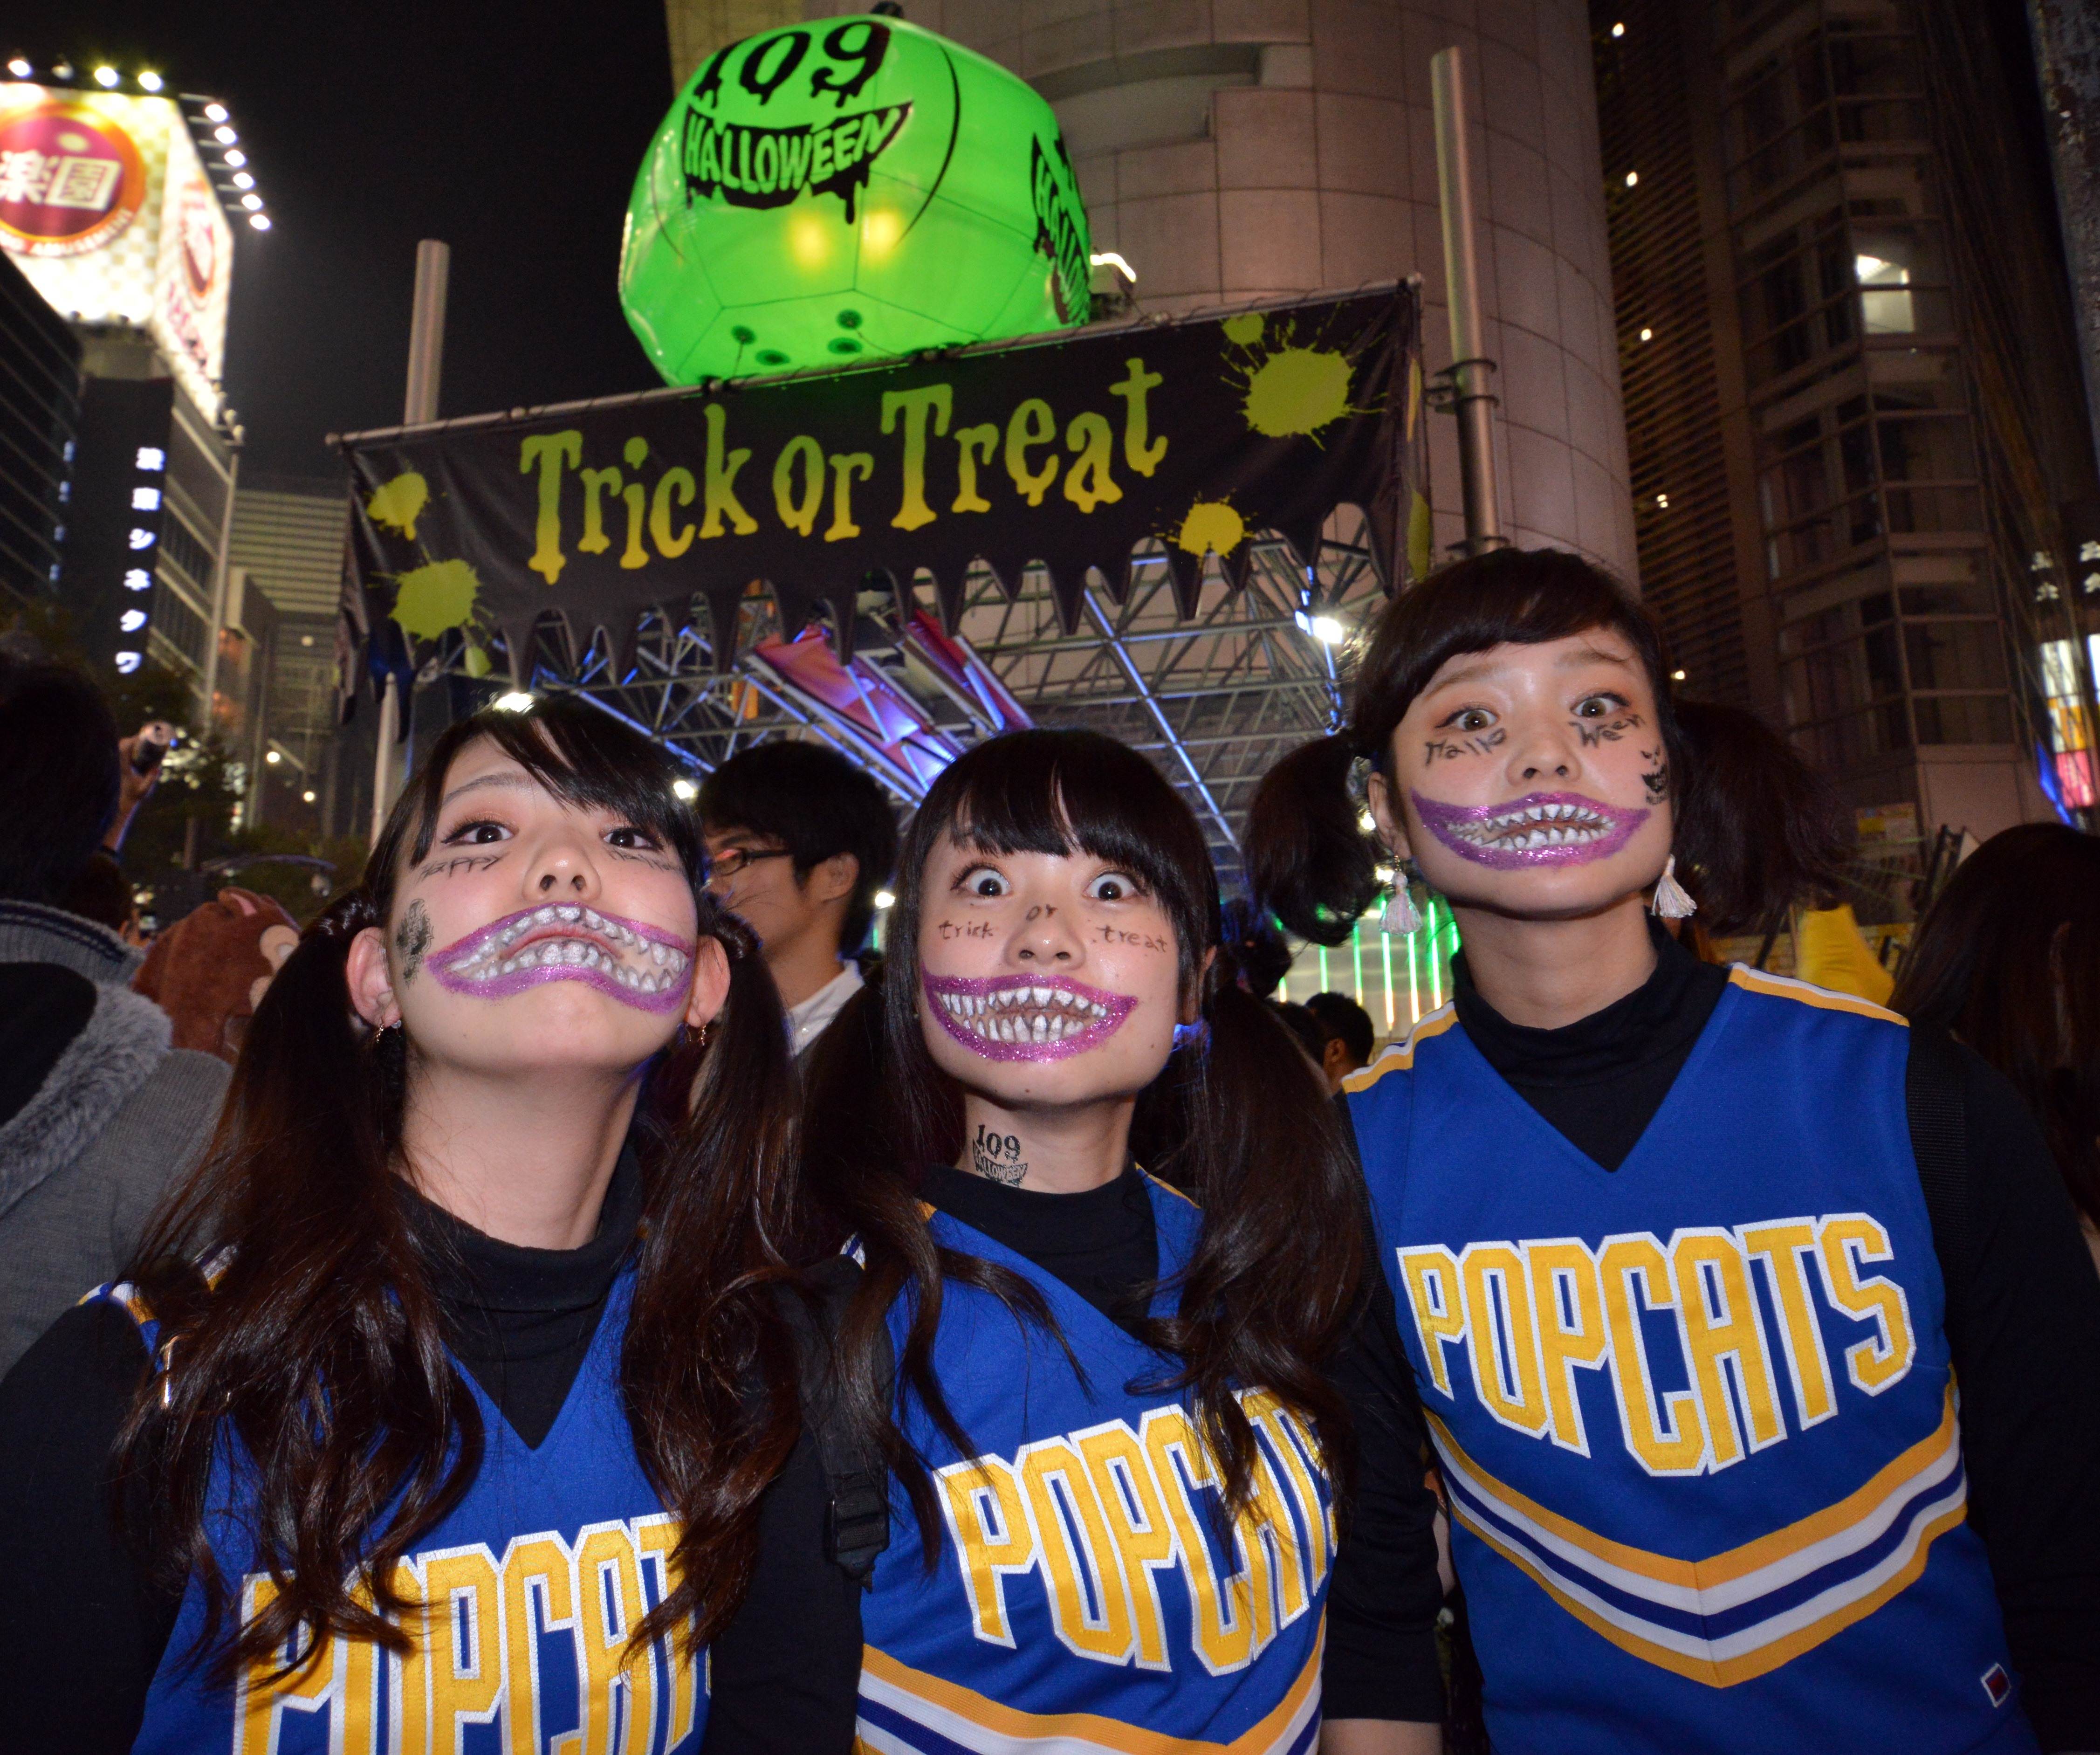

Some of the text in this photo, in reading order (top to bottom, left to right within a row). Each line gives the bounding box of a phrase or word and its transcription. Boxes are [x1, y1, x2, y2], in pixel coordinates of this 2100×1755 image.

[693, 21, 891, 109] 109
[0, 149, 122, 211] 楽園
[684, 107, 901, 194] HALLOWEEN
[520, 402, 758, 585] Trick
[881, 358, 1168, 531] Treat
[1026, 903, 1058, 922] or
[1096, 924, 1167, 953] treat
[976, 1124, 1021, 1164] 109
[1396, 1212, 1917, 1477] POPCATS
